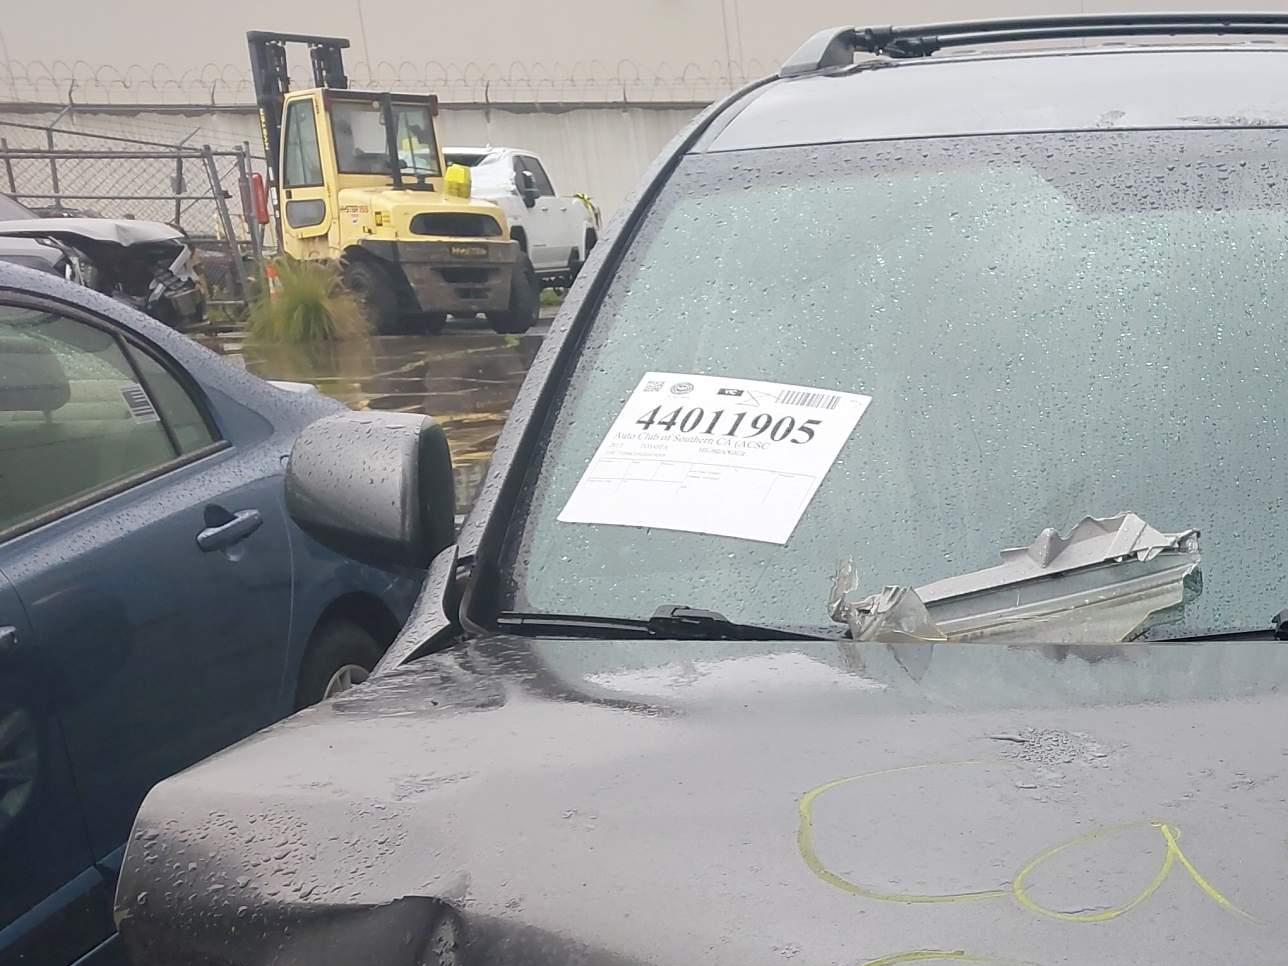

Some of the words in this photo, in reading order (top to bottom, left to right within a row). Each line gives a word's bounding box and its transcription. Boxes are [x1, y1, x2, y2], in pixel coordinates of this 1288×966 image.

[615, 431, 636, 441] Auto
[637, 432, 659, 442] Club
[660, 434, 672, 442] of
[673, 435, 714, 446] Southern
[635, 404, 824, 445] 44011905
